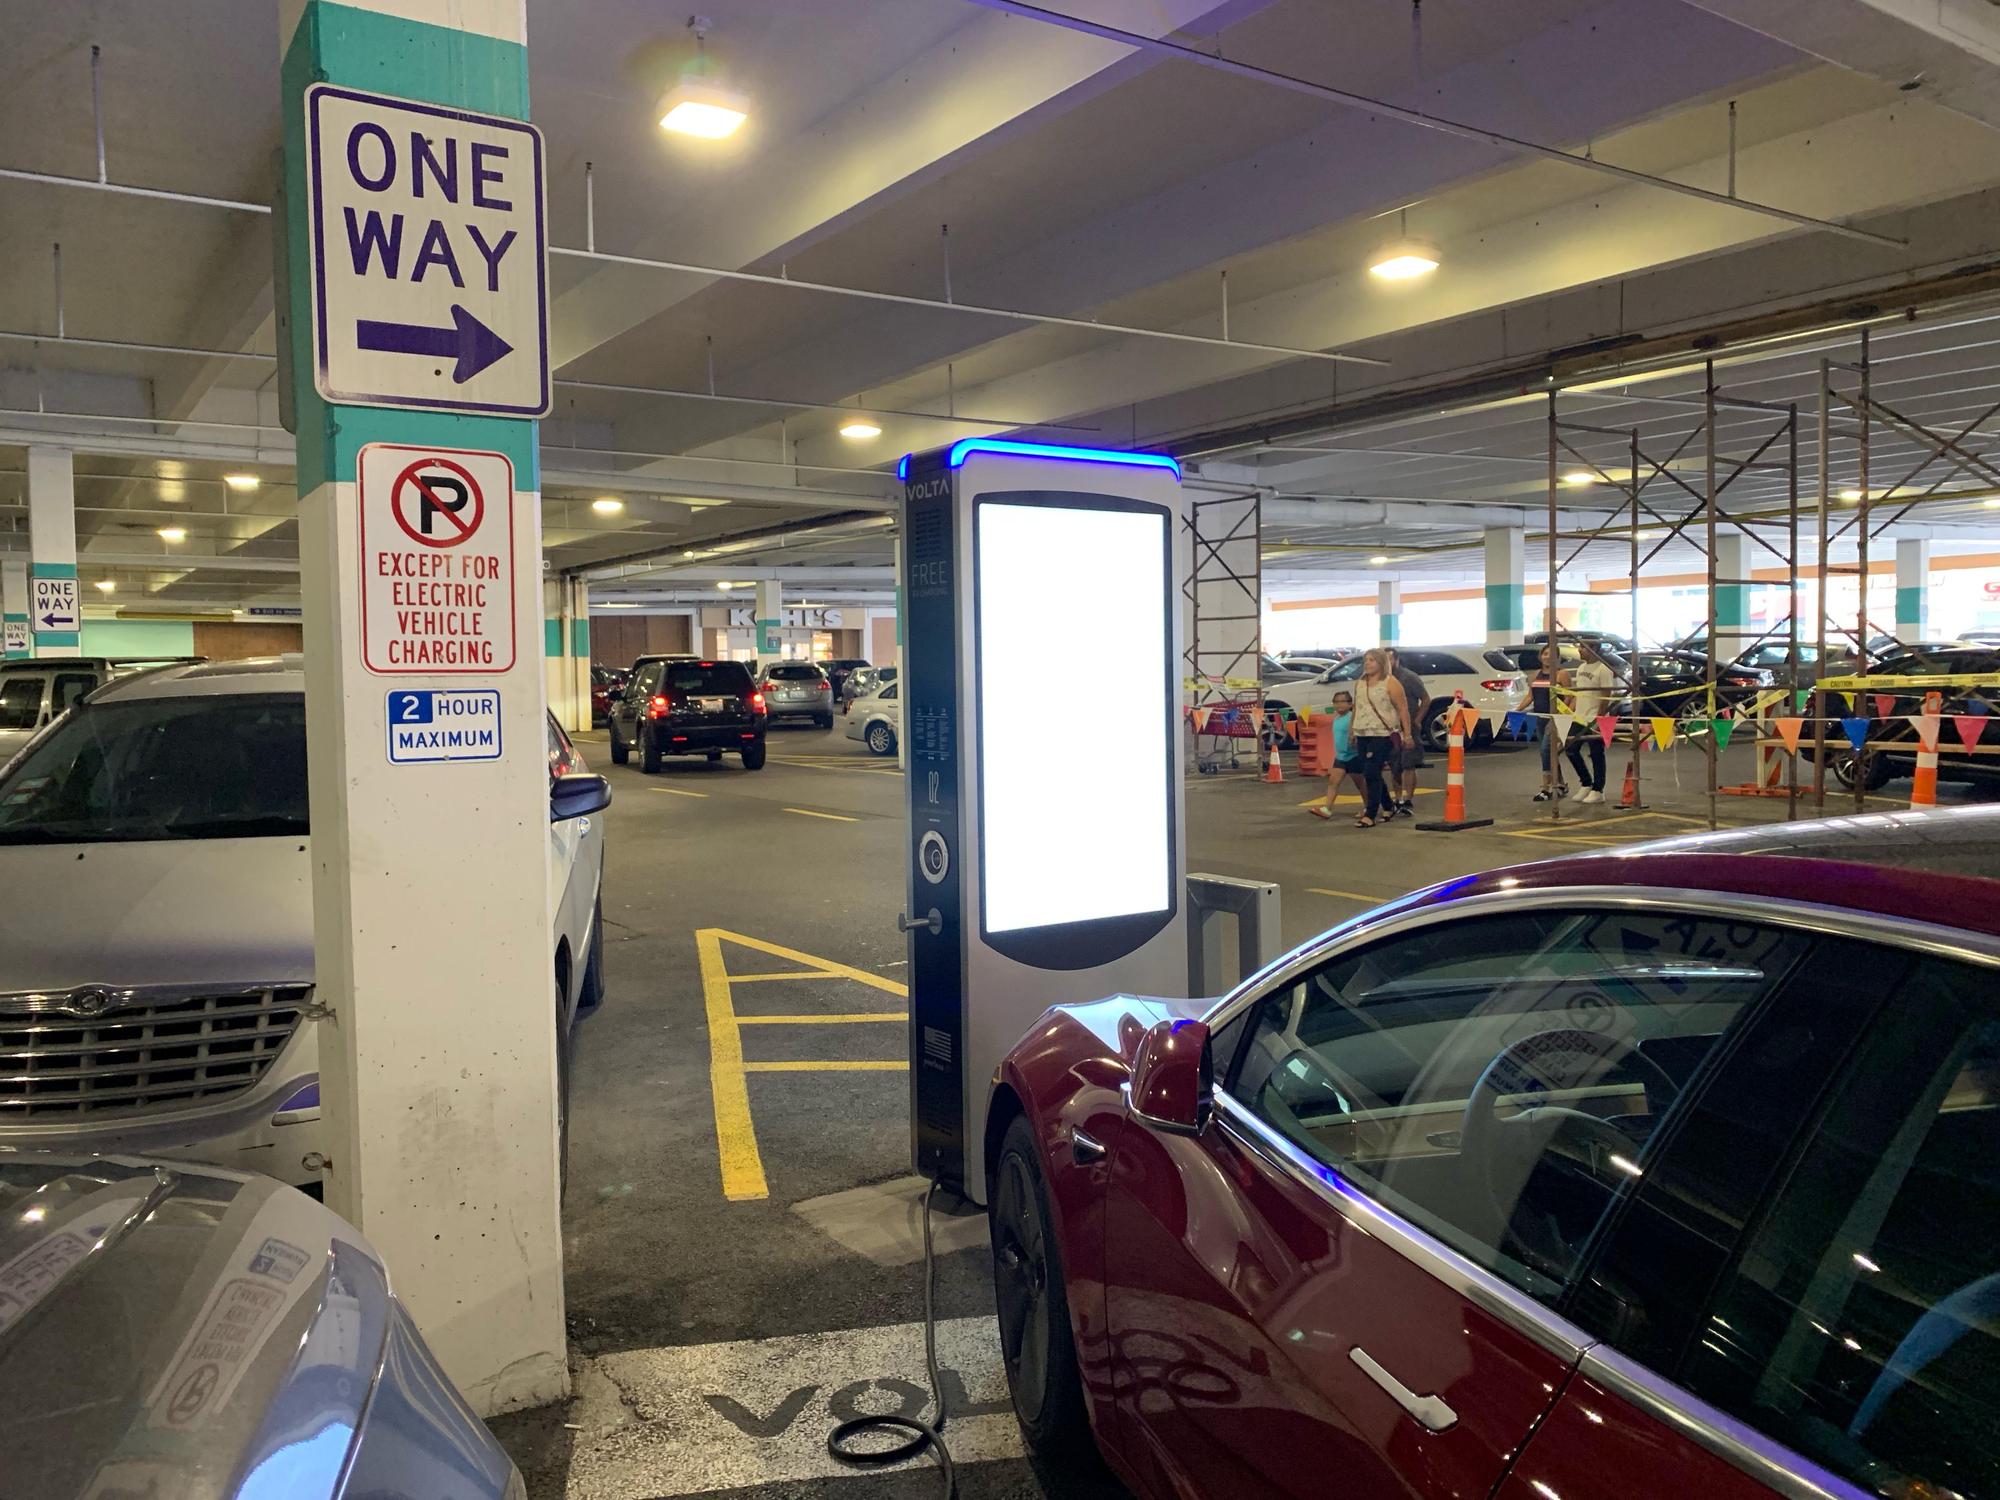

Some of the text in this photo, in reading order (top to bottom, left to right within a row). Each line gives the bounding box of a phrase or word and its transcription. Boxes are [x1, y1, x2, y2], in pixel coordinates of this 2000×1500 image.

[347, 122, 512, 211] ONE
[343, 207, 517, 291] WAY
[907, 478, 949, 501] VOLTA
[379, 553, 499, 579] EXCEPT FOR
[912, 561, 947, 586] FREE
[38, 582, 73, 595] ONE
[393, 582, 486, 607] ELECTRIC
[38, 598, 73, 610] WAY
[397, 612, 482, 635] VEHICLE
[729, 609, 842, 626] KHL'S
[389, 640, 493, 664] CHARGING
[402, 695, 492, 720] 2 HOUR
[400, 730, 492, 748] MAXIMUM
[929, 771, 939, 804] 02
